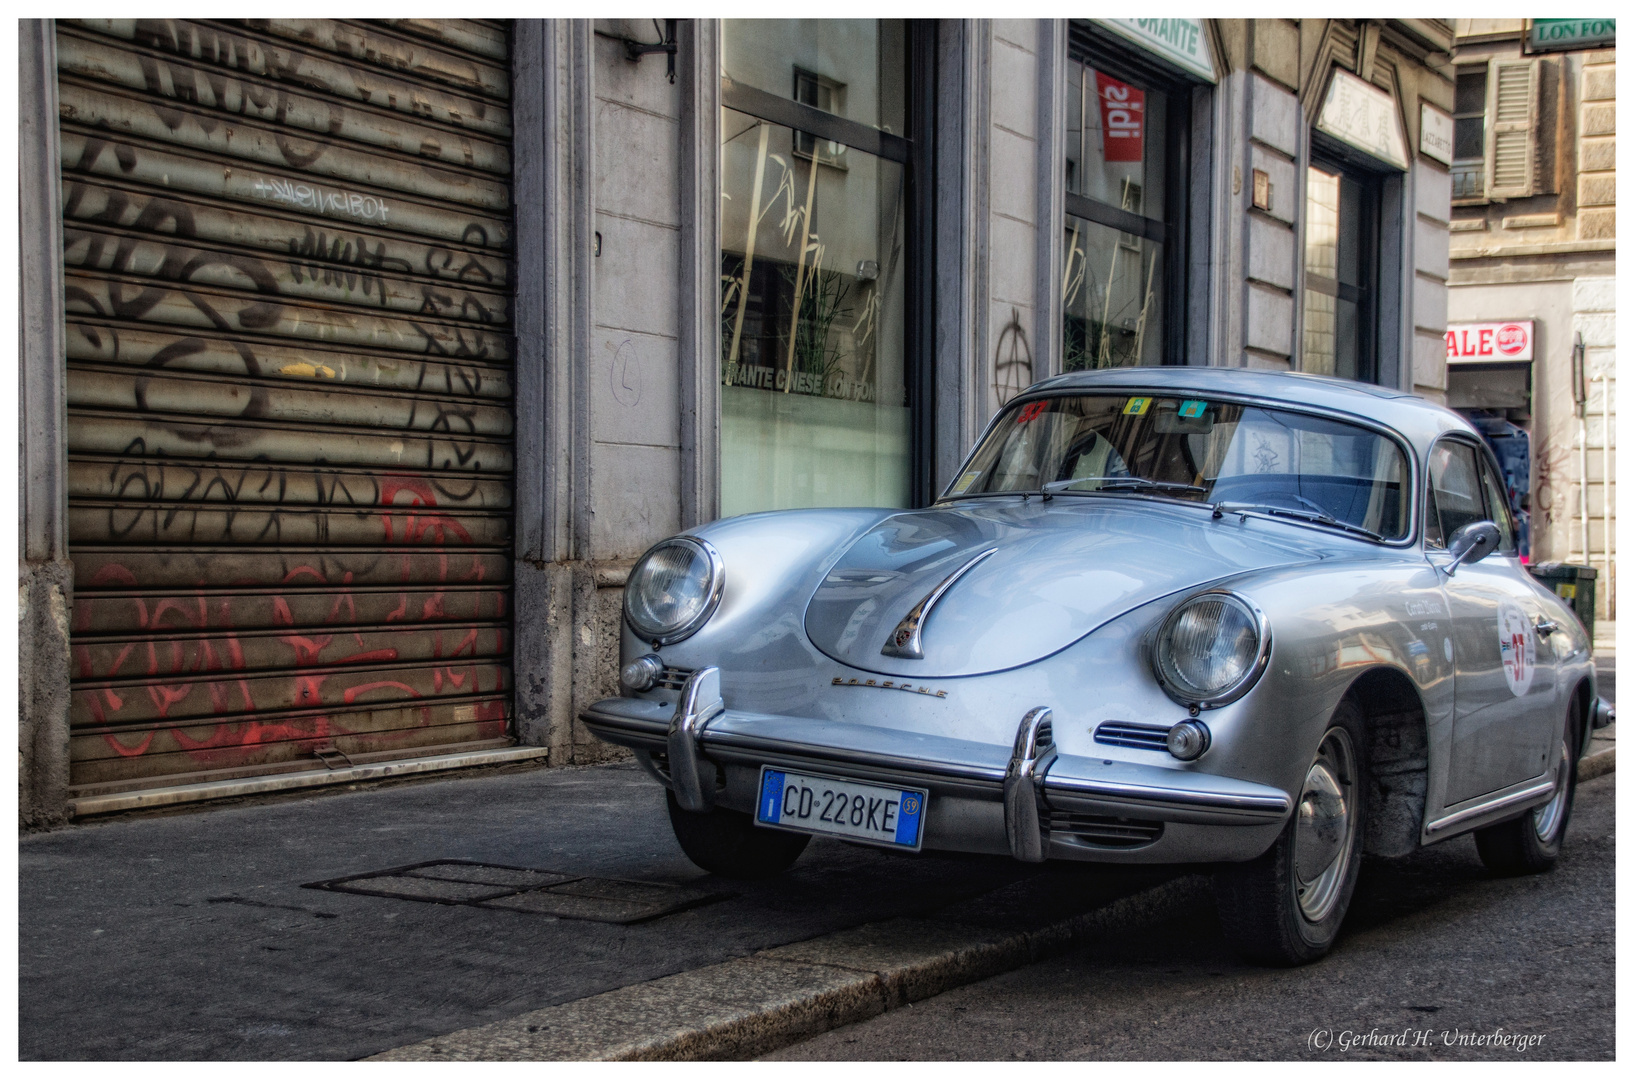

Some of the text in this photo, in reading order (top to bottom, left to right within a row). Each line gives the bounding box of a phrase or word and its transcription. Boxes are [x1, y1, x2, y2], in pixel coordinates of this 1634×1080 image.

[1538, 23, 1576, 41] LON
[1017, 401, 1048, 424] 37
[832, 677, 949, 699] PORSCHE
